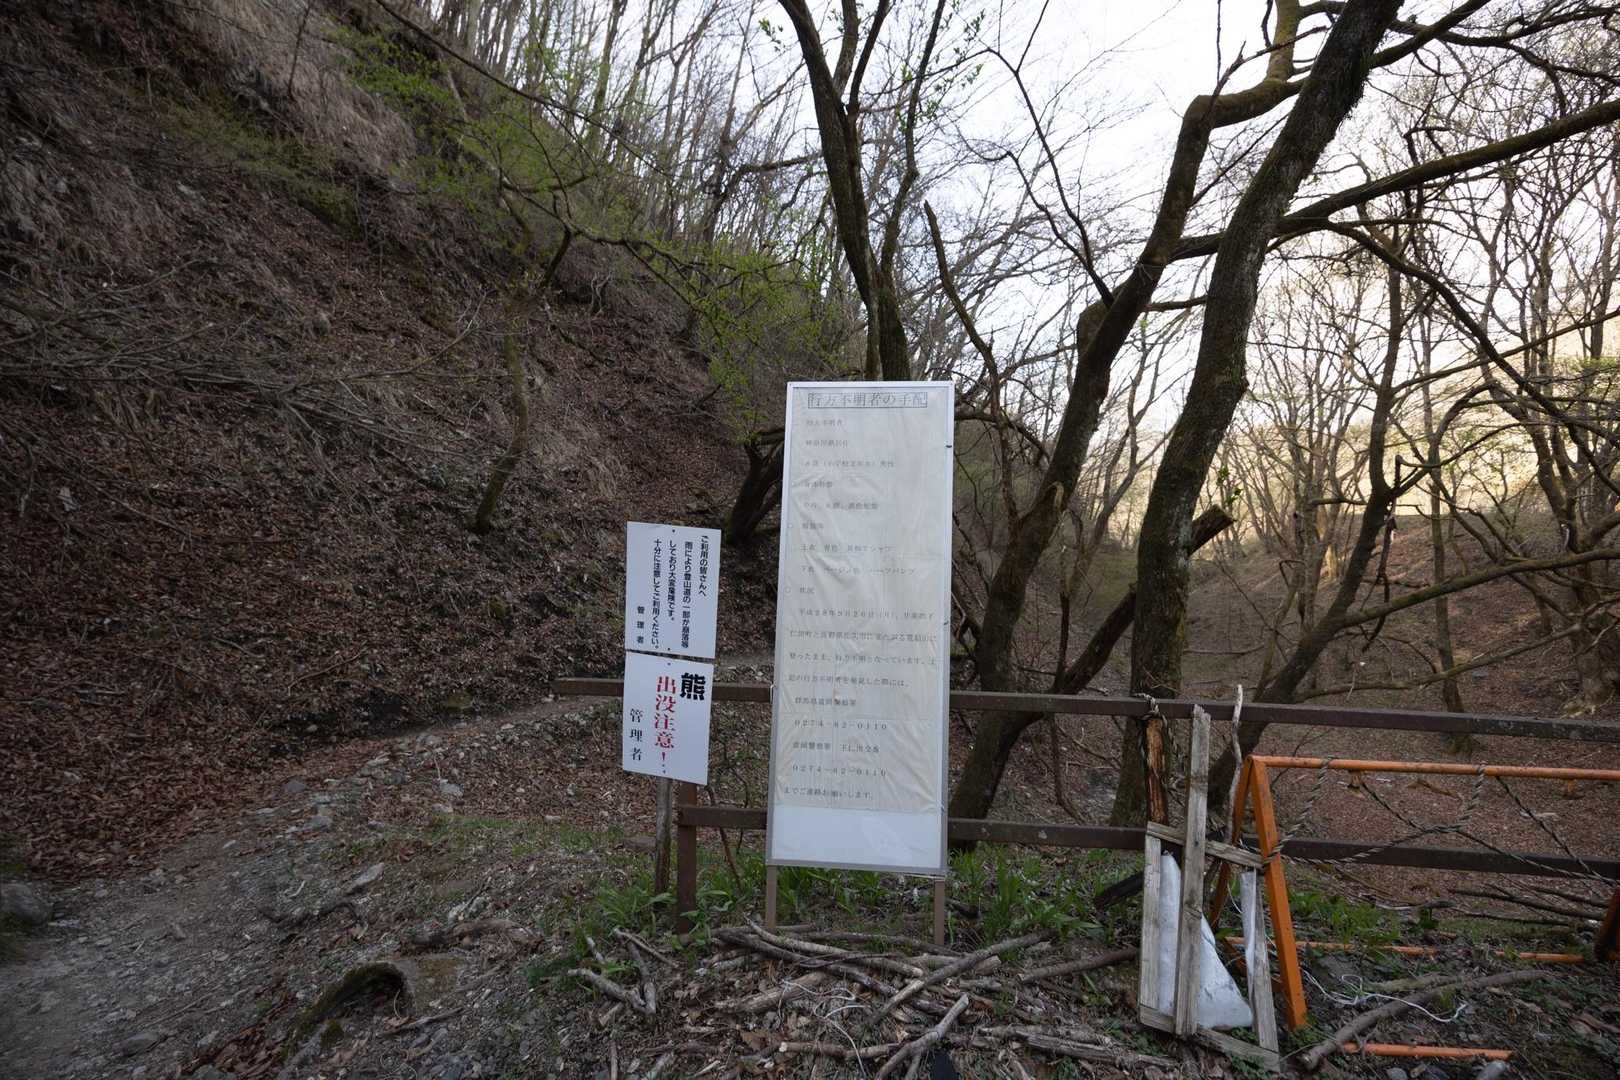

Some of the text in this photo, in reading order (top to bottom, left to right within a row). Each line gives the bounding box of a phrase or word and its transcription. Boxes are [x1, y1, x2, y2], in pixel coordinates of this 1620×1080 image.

[809, 392, 926, 408] 行方不明者の手配
[698, 535, 709, 597] ご利用の皆さんへ
[651, 538, 662, 649] 十分に注意してご利用ください。
[680, 672, 706, 701] 熊
[629, 708, 644, 761] 管理者
